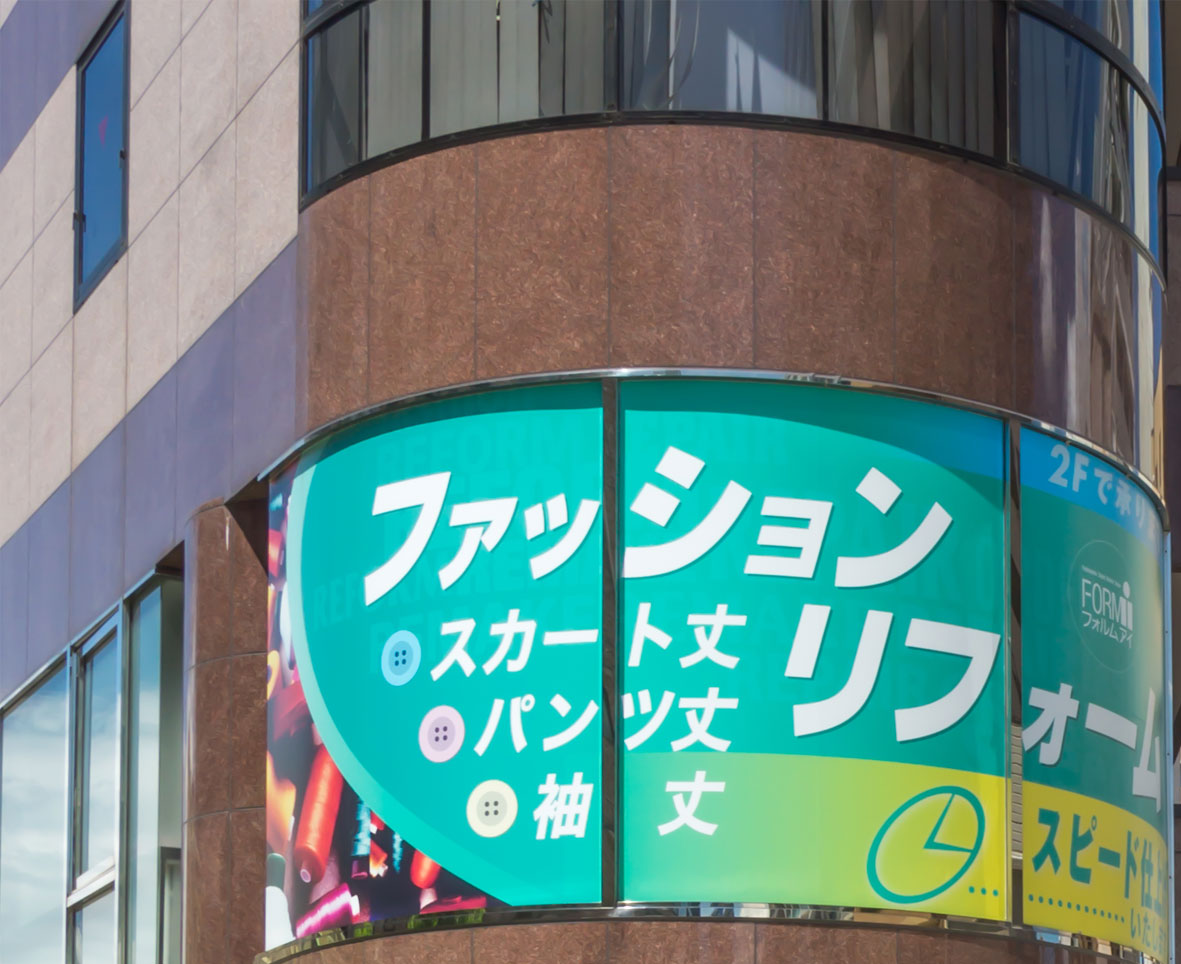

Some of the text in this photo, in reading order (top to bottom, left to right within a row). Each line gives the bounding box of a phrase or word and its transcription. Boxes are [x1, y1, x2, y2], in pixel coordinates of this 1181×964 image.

[364, 446, 952, 606] ファッション
[430, 602, 747, 681] スカート丈
[474, 687, 739, 757] パンツ丈
[784, 604, 1163, 814] リフォーム
